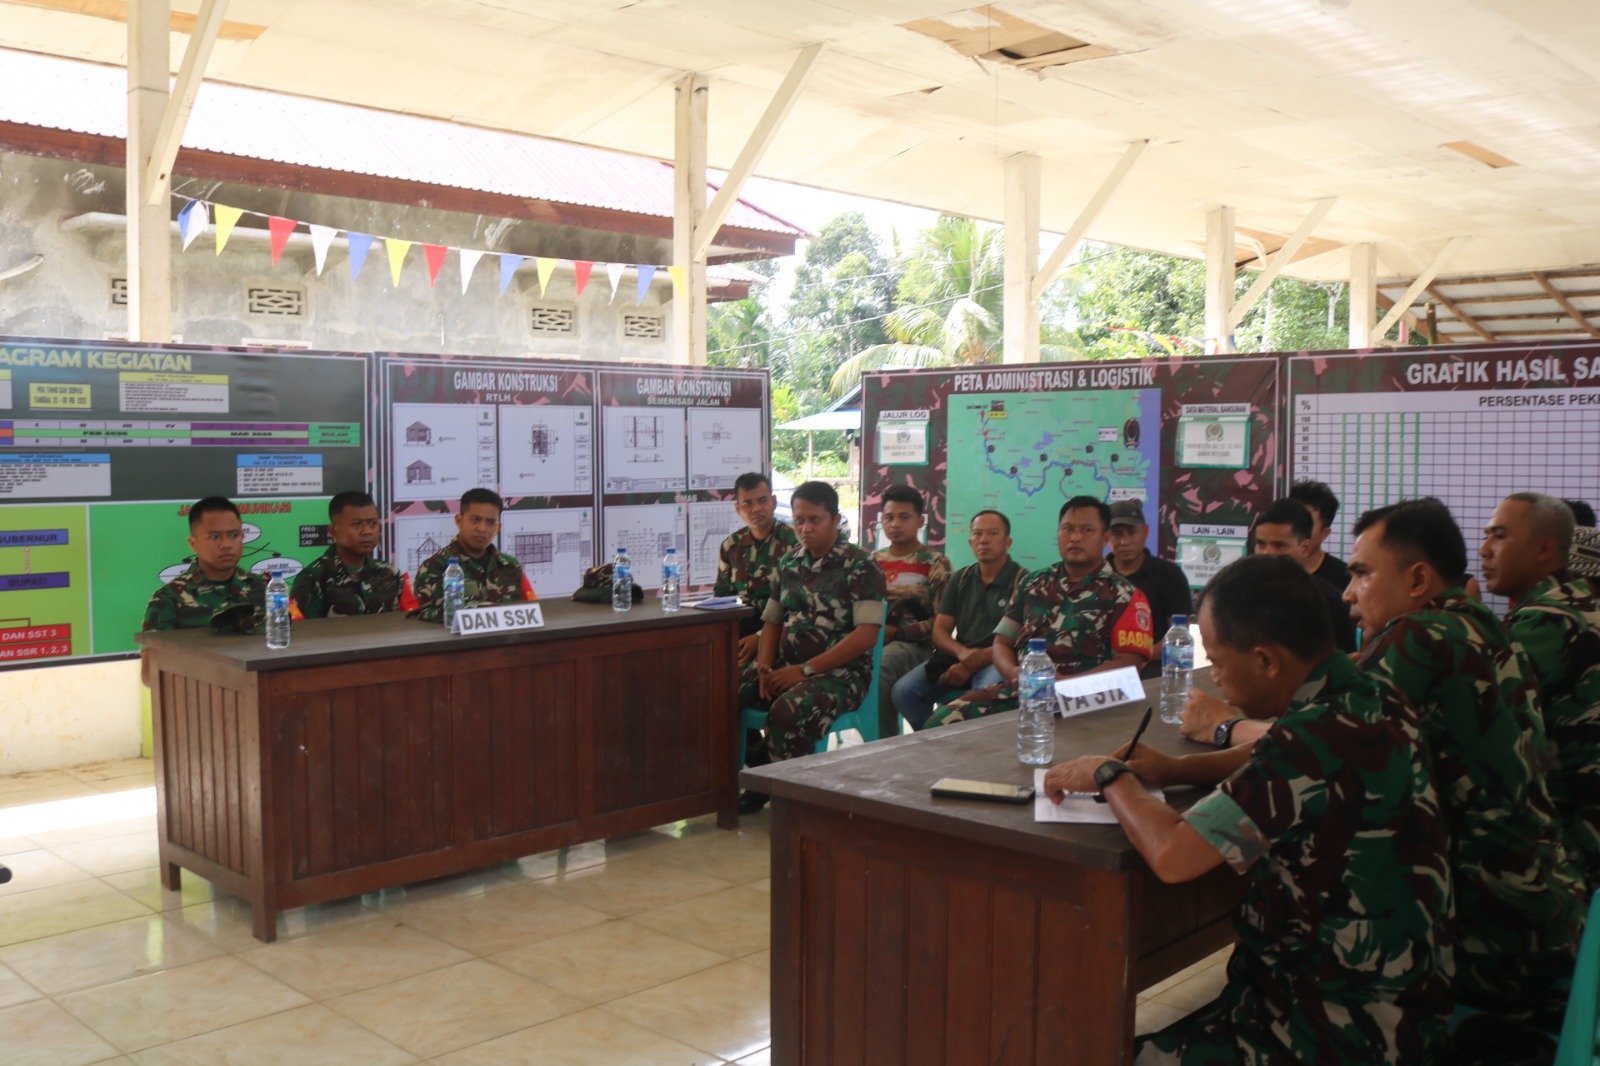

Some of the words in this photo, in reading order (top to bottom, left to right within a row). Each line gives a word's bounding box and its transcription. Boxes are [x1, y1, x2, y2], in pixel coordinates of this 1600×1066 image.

[87, 351, 192, 372] KEGIATAN
[1406, 361, 1490, 385] GRAFIK
[1496, 358, 1567, 382] HASIL
[1573, 356, 1600, 380] SA
[454, 371, 496, 391] GAMBAR
[498, 373, 559, 392] KONSTRUKSI
[954, 373, 983, 391] PETA
[985, 369, 1074, 390] ADMINISTRASI
[1077, 369, 1088, 387] &
[1090, 367, 1154, 387] LOGISTIK
[636, 378, 675, 395] GAMBAR
[677, 379, 732, 397] KONSTRUKSI
[486, 394, 511, 402] RTLH
[647, 397, 695, 406] SEMENISASI
[696, 398, 721, 406] JALAN
[1479, 394, 1566, 407] PERSENTASE
[1569, 393, 1600, 406] PEK
[1301, 400, 1312, 410] %
[883, 411, 908, 419] JALUR
[236, 501, 292, 515] MUNIKASI
[1192, 526, 1210, 535] LAIN
[1217, 527, 1235, 536] LAIN
[8, 577, 48, 587] BUPATI
[460, 612, 499, 631] DAN
[504, 608, 540, 627] SSK
[2, 631, 25, 641] DAN
[27, 629, 48, 639] SST
[50, 629, 57, 637] 3
[16, 647, 38, 657] SSR
[62, 644, 68, 653] 3
